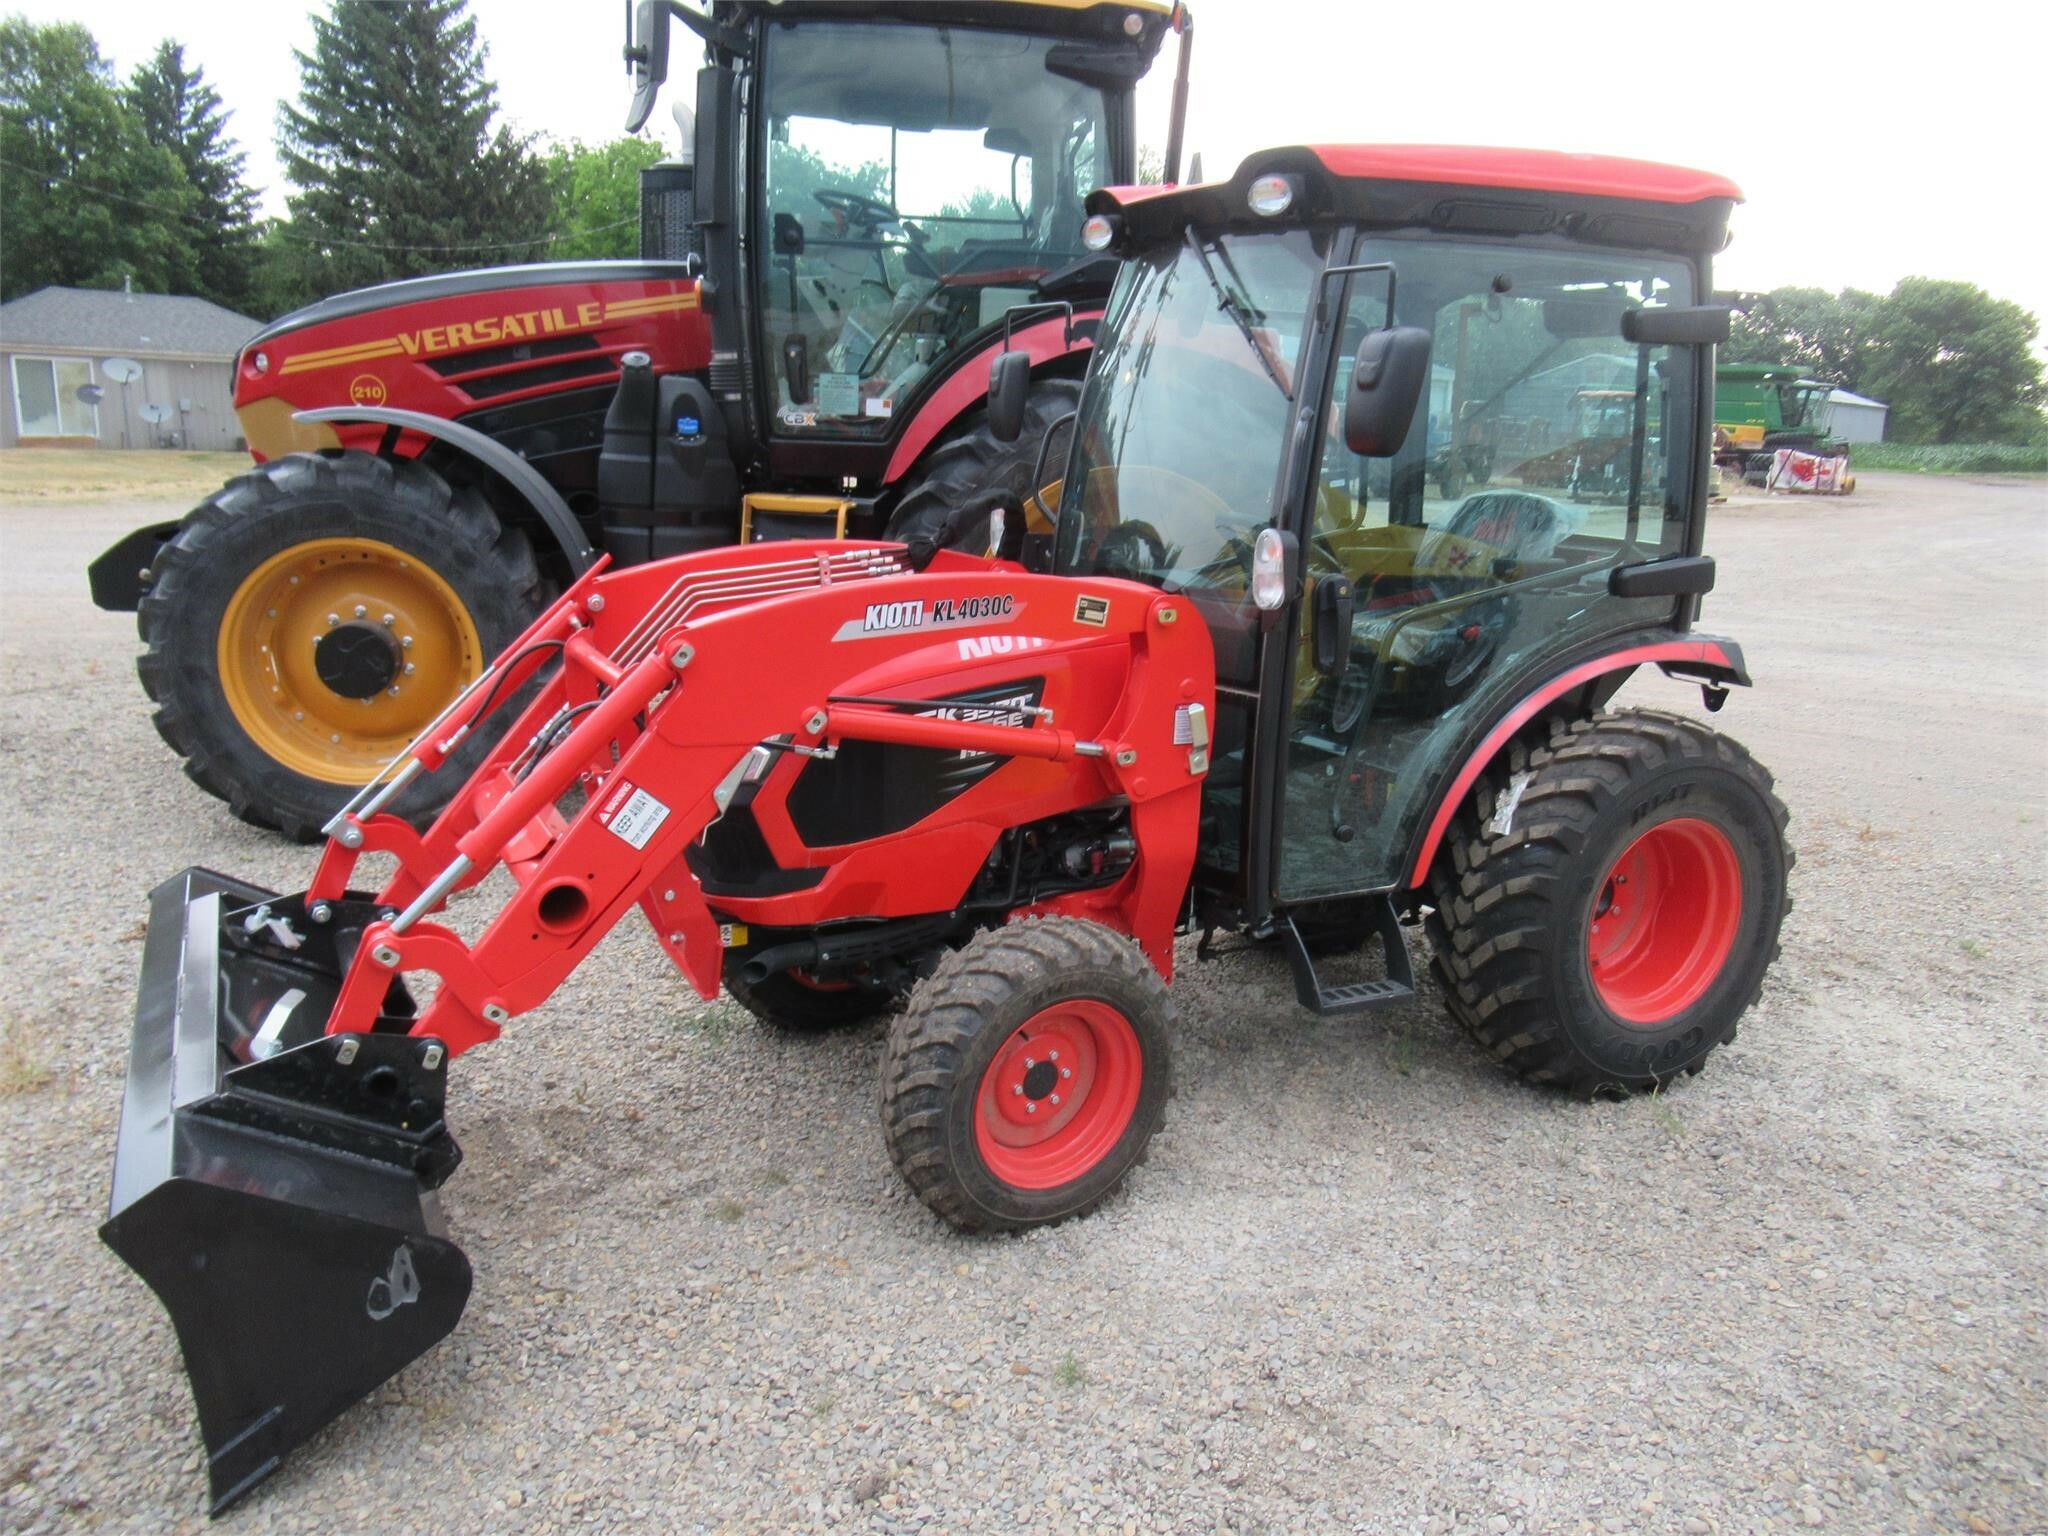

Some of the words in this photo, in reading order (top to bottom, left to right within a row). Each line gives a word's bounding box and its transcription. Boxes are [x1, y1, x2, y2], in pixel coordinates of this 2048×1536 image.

[398, 303, 602, 355] VERSATILE
[355, 386, 381, 398] 210
[864, 601, 923, 631] KIOTI
[933, 594, 1014, 622] KL4030C
